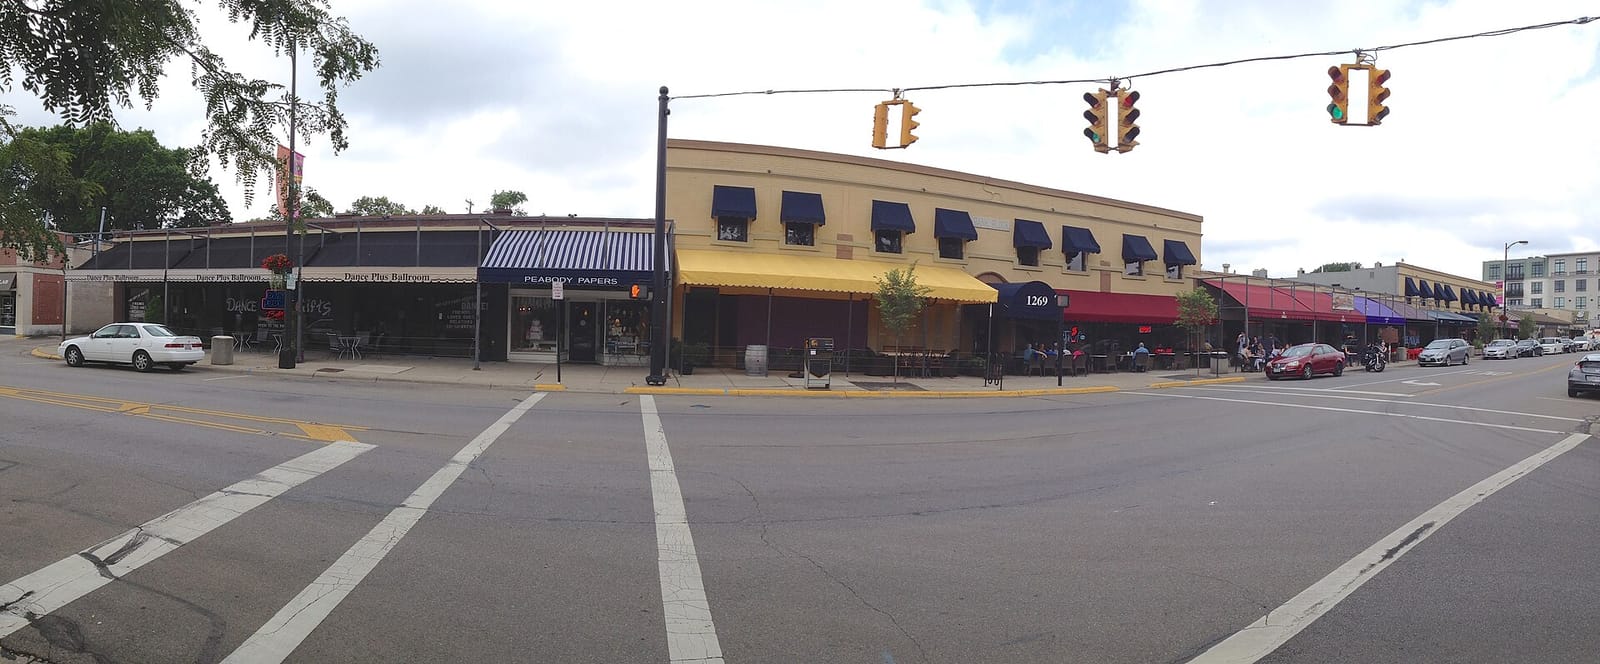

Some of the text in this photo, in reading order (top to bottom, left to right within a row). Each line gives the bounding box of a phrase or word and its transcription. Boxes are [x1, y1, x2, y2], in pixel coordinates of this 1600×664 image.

[392, 273, 430, 281] Ballroom
[524, 276, 618, 285] PEABODY PAPERS
[226, 297, 257, 314] DANCE
[299, 298, 332, 316] ifts
[1026, 295, 1048, 307] 1269
